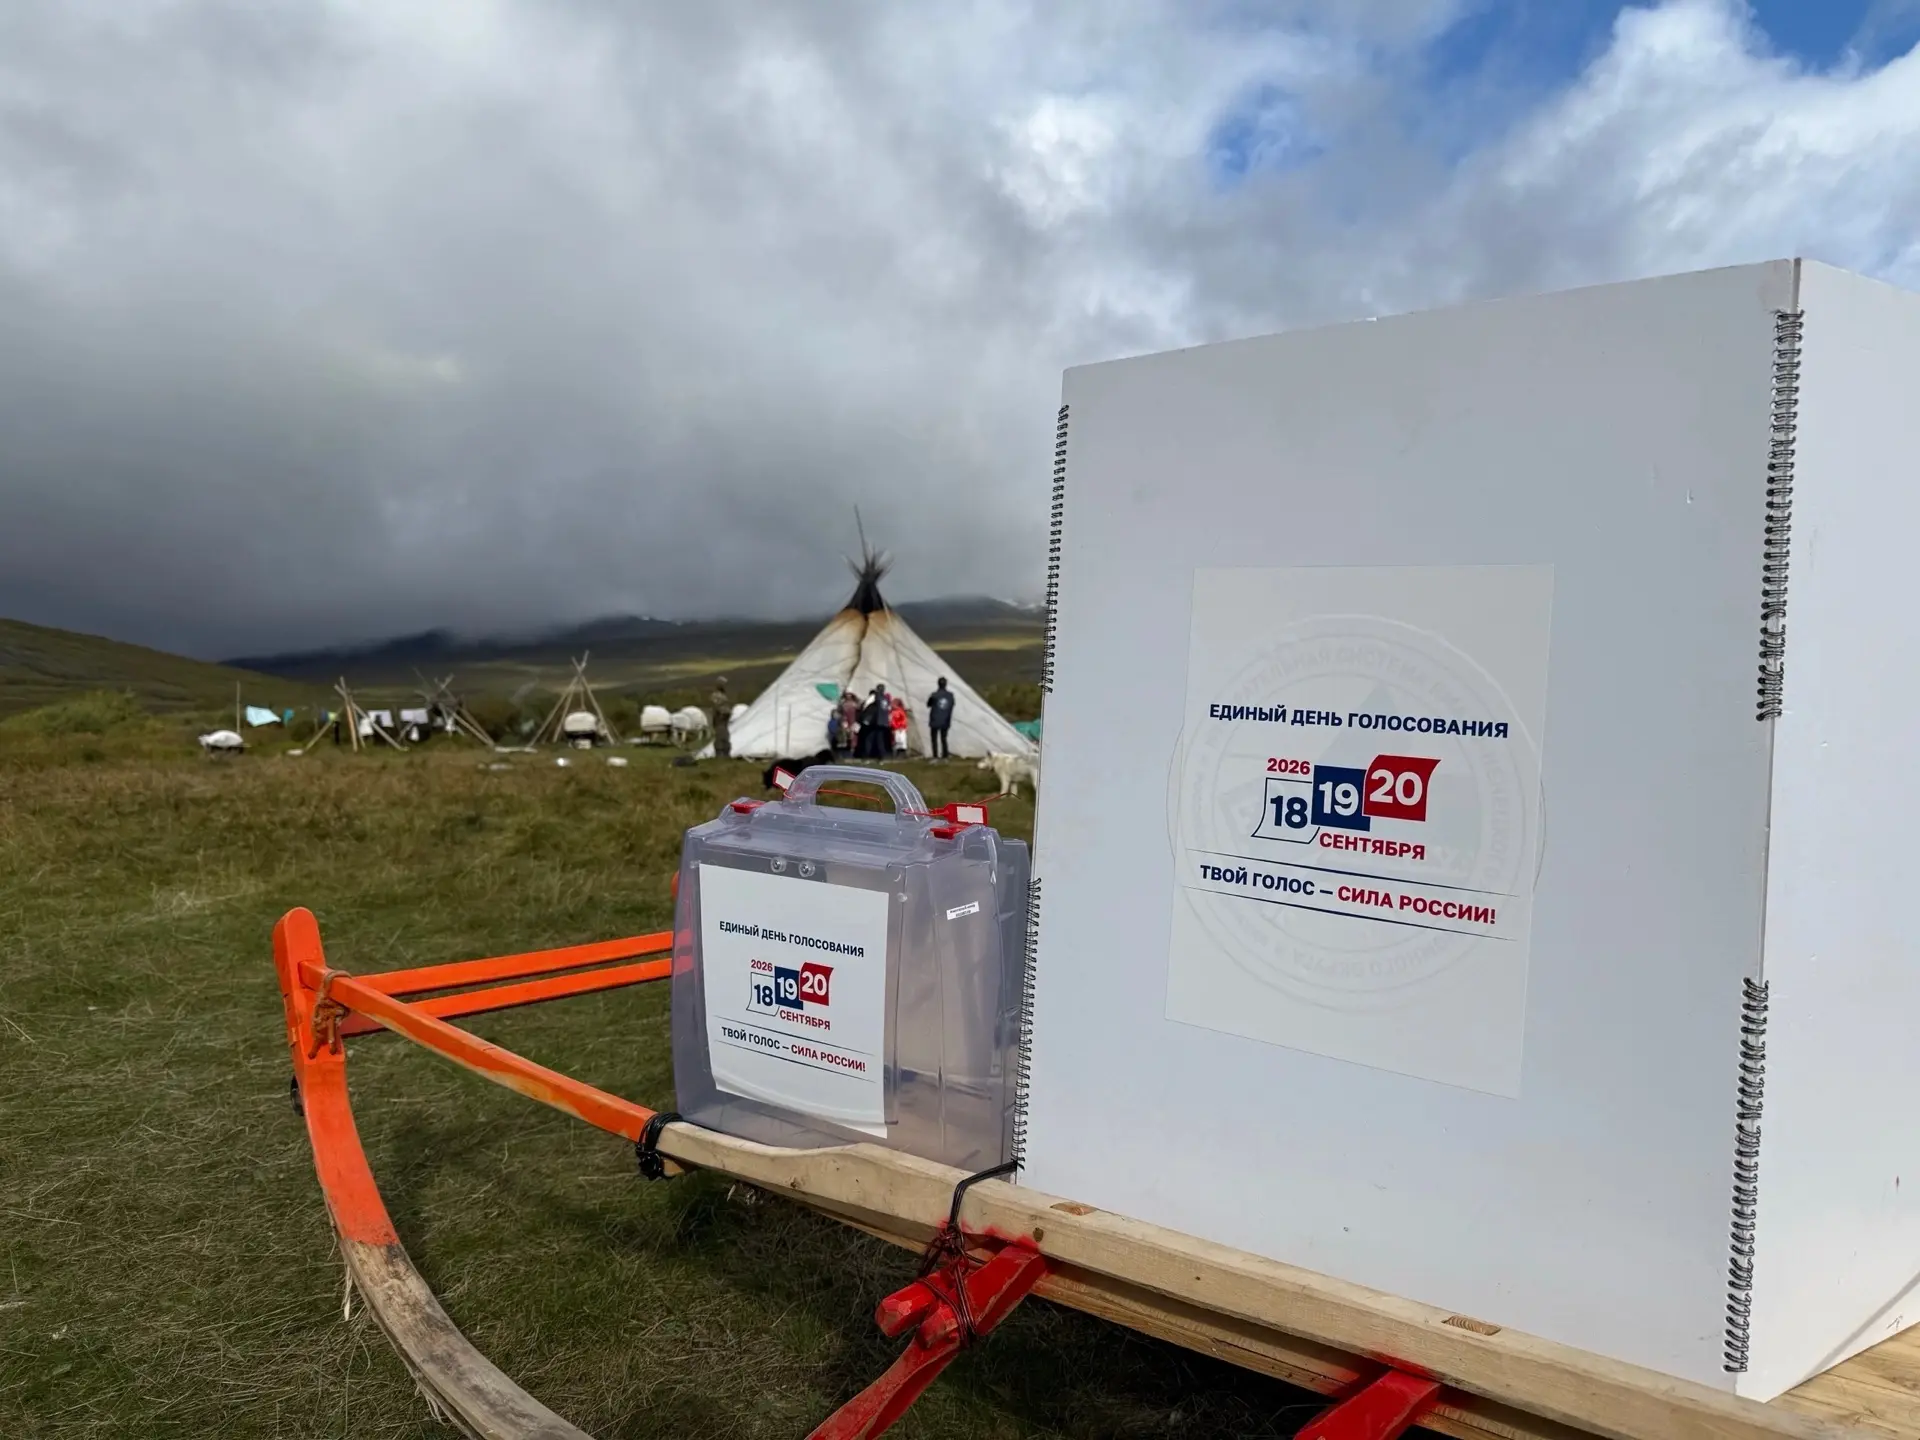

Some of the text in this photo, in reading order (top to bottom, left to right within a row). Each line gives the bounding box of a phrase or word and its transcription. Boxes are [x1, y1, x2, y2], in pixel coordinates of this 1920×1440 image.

[1210, 704, 1508, 738] ЕДИНЫЙ ДЕНЬ ГОЛОСОВАНИЯ
[1267, 758, 1310, 775] 2026
[1270, 769, 1422, 829] 18 19 20
[1320, 833, 1425, 860] СЕНТЯБРЯ
[1200, 865, 1247, 885] ТВОЙ
[1252, 873, 1315, 896] ГОЛОС
[1338, 886, 1393, 908] СИЛА
[1399, 896, 1495, 924] РОССИИ!
[720, 921, 863, 957] ЕДИНЫЙ ДЕНЬ ГОЛОСОВАНИЯ
[751, 959, 772, 973] 2026
[754, 972, 826, 1006] 18 19 20
[780, 1010, 830, 1030] СЕНТЯБРЯ
[722, 1027, 746, 1041] ТВОЙ
[749, 1033, 780, 1050] ГОЛОС
[791, 1044, 818, 1060] СИЛА
[821, 1052, 865, 1072] РОССИИ!
